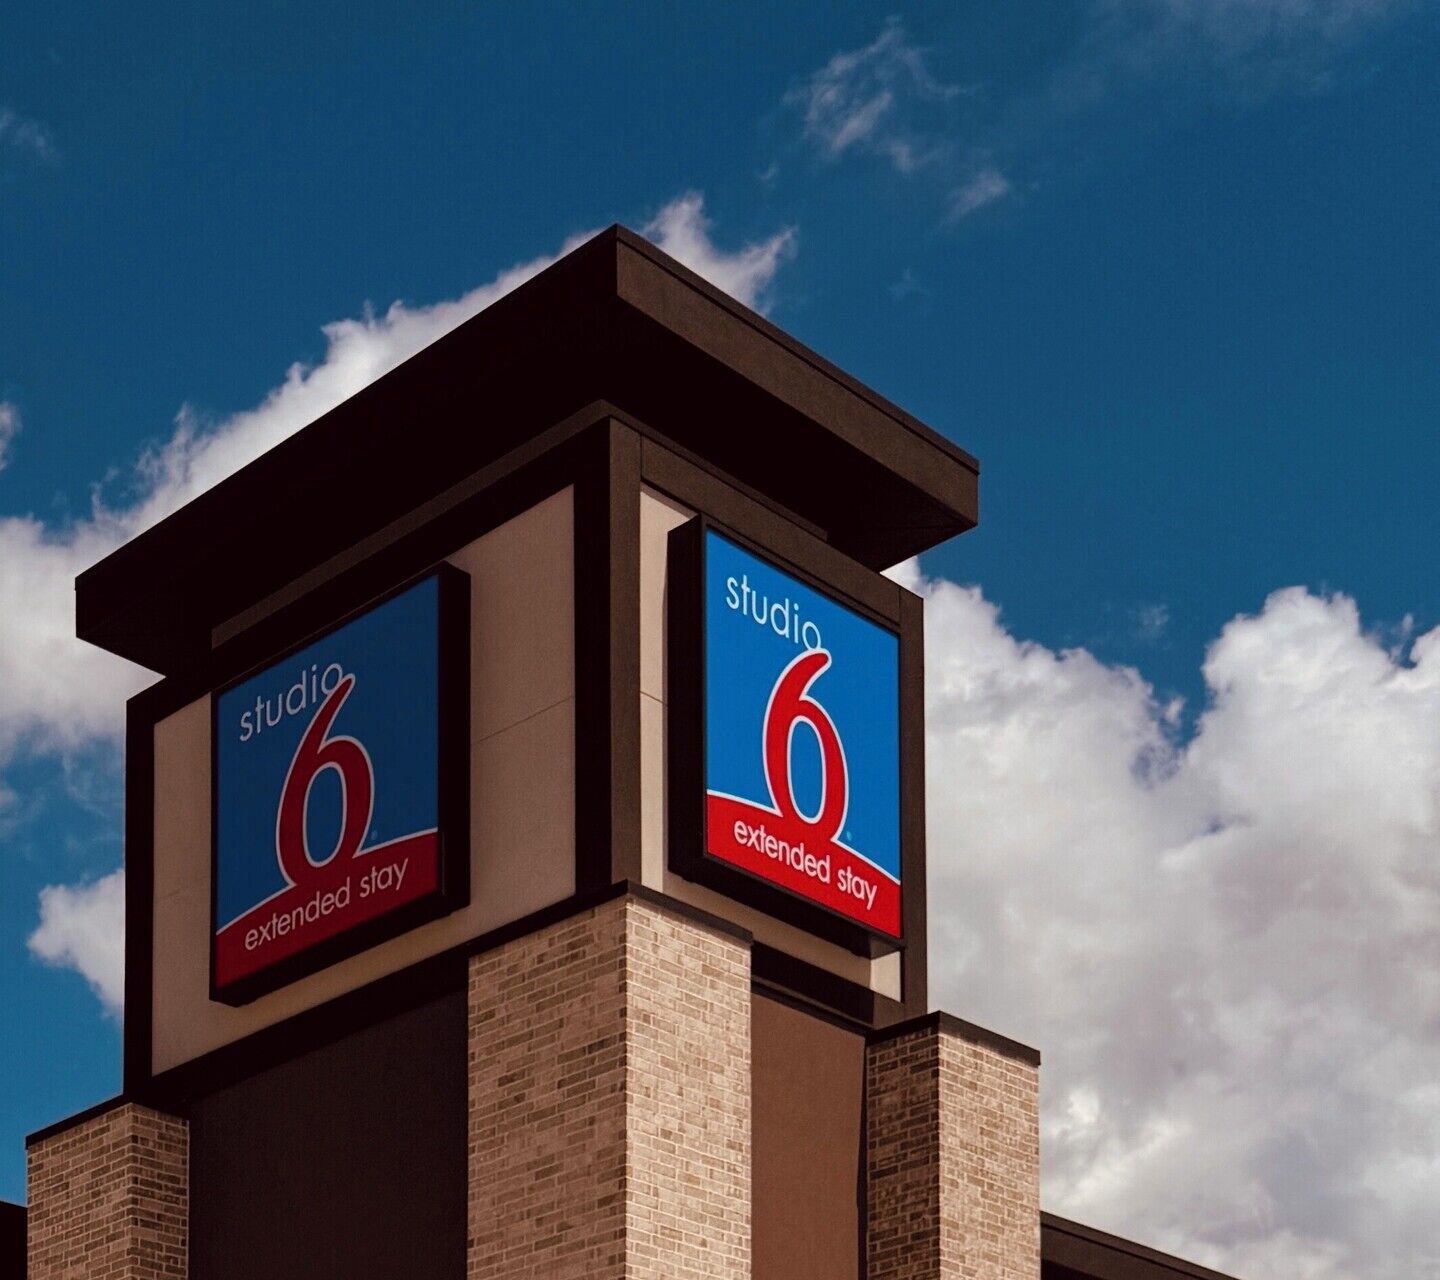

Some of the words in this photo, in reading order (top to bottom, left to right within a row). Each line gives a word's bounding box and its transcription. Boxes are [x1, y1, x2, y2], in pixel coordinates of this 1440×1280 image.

[726, 575, 821, 650] studio
[239, 663, 343, 742] studio
[762, 648, 850, 841] 6
[275, 673, 375, 887] 6
[245, 877, 350, 950] extended
[360, 858, 409, 898] stay
[734, 820, 830, 884] extended
[837, 866, 878, 910] stay
